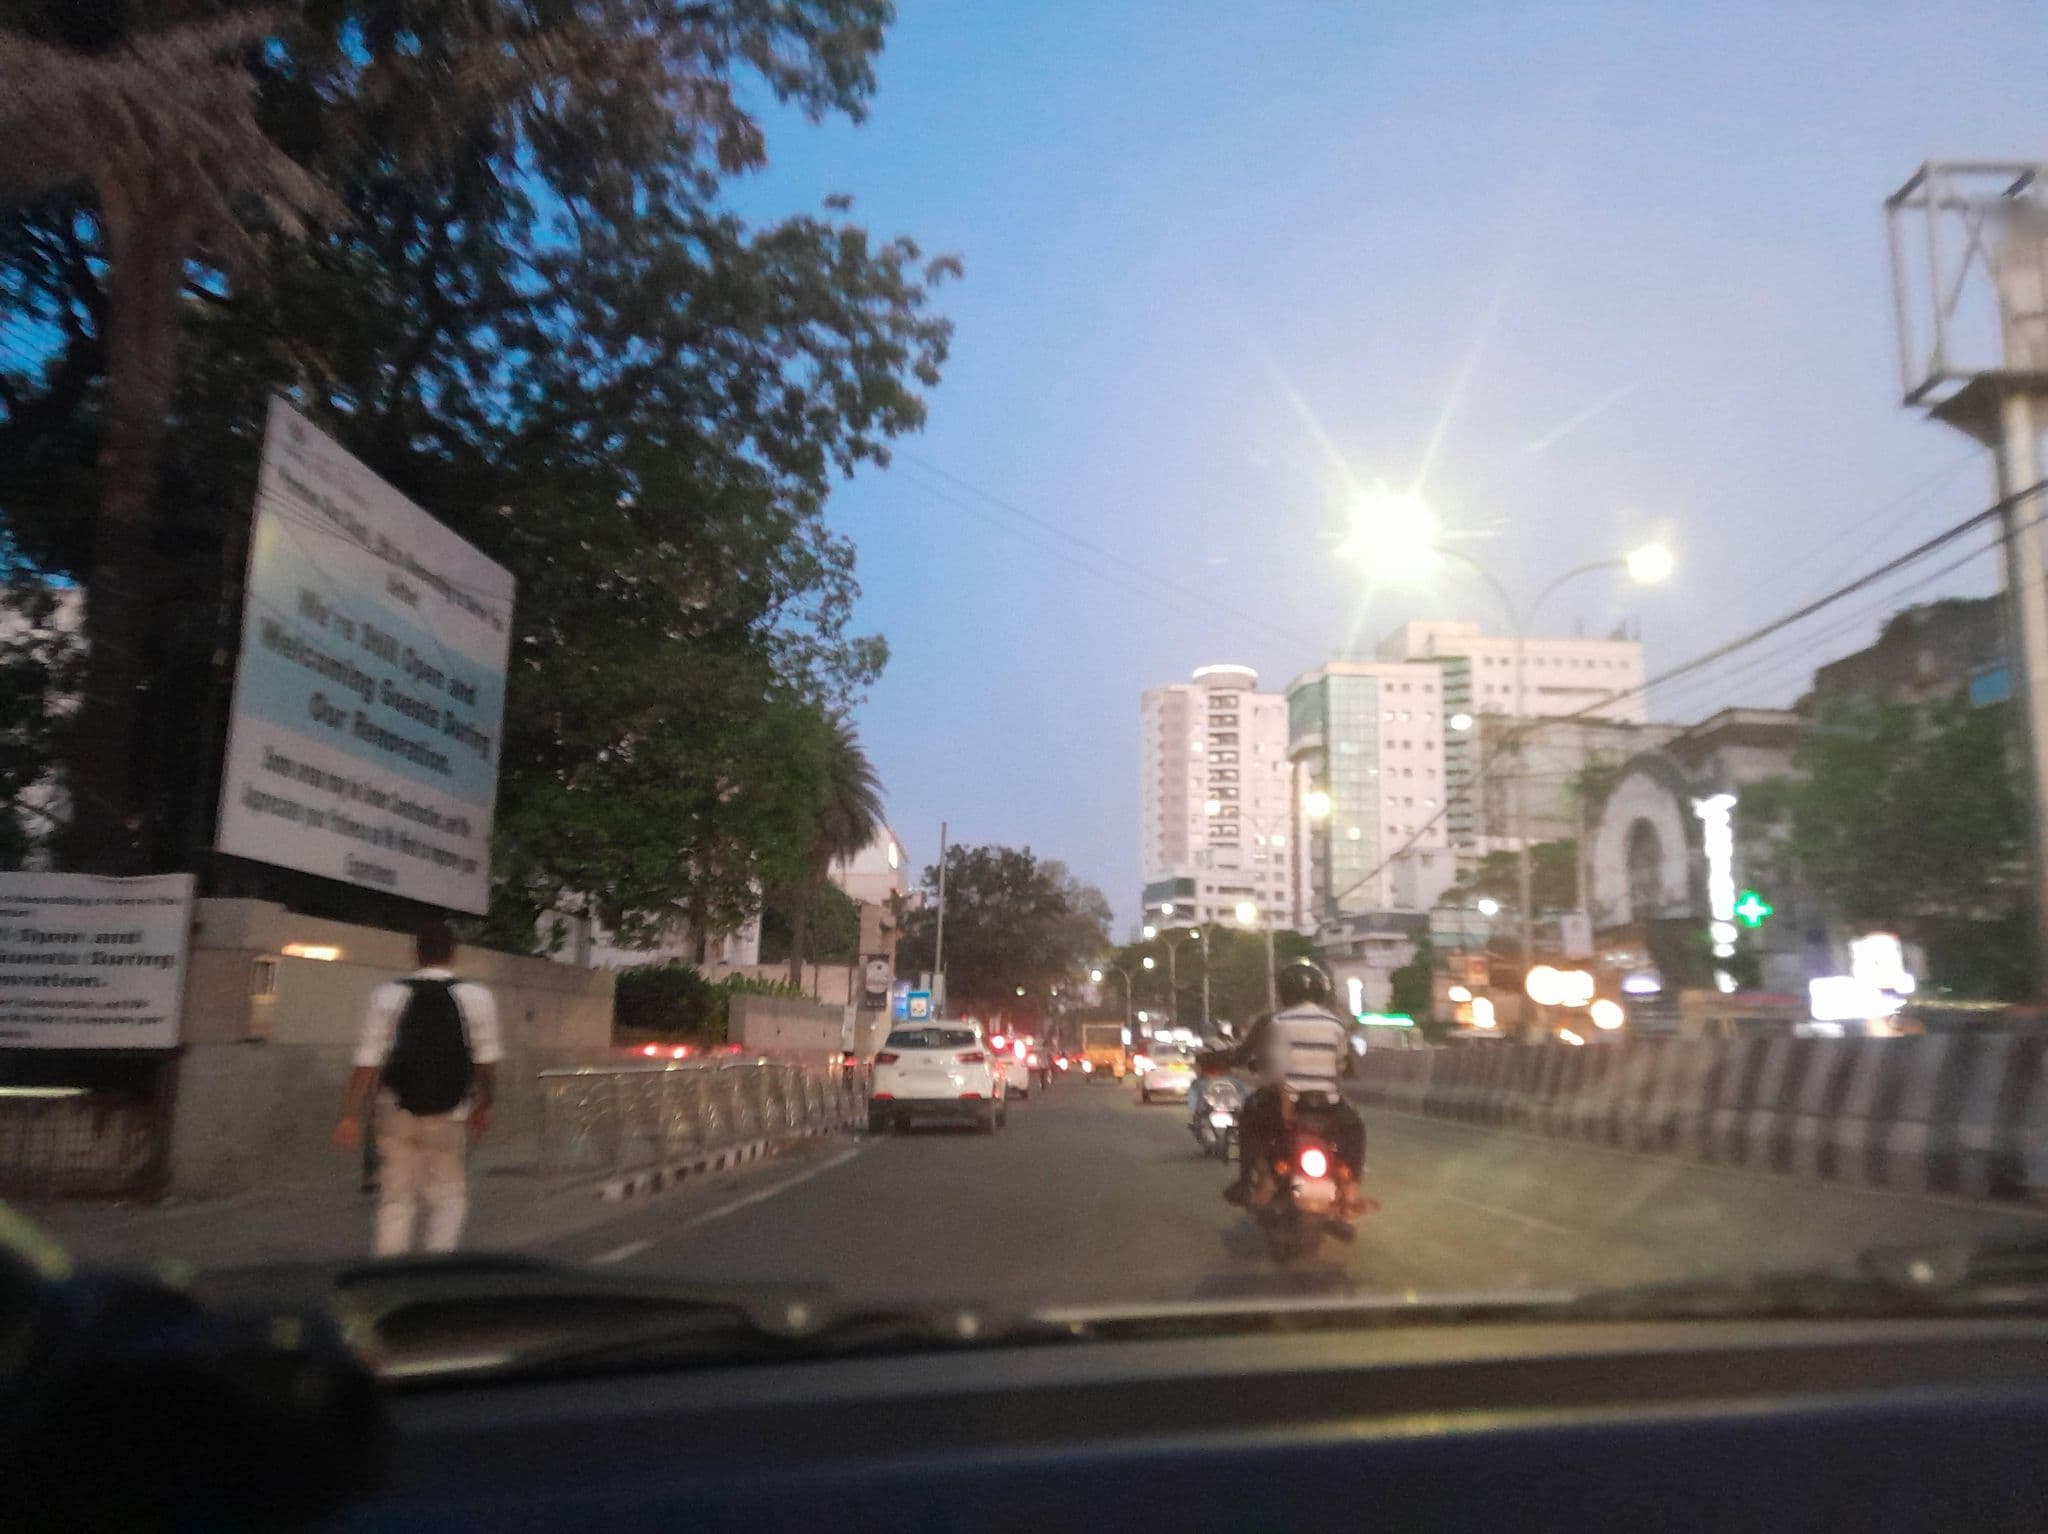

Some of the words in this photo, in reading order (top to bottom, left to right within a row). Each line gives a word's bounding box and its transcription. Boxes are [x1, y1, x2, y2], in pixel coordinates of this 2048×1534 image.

[259, 615, 375, 704] Welcoming
[380, 678, 440, 729] Guests
[444, 709, 491, 761] During
[404, 646, 445, 691] Open
[449, 676, 478, 707] and
[308, 690, 349, 729] Our
[94, 928, 143, 944] and
[90, 950, 175, 969] During
